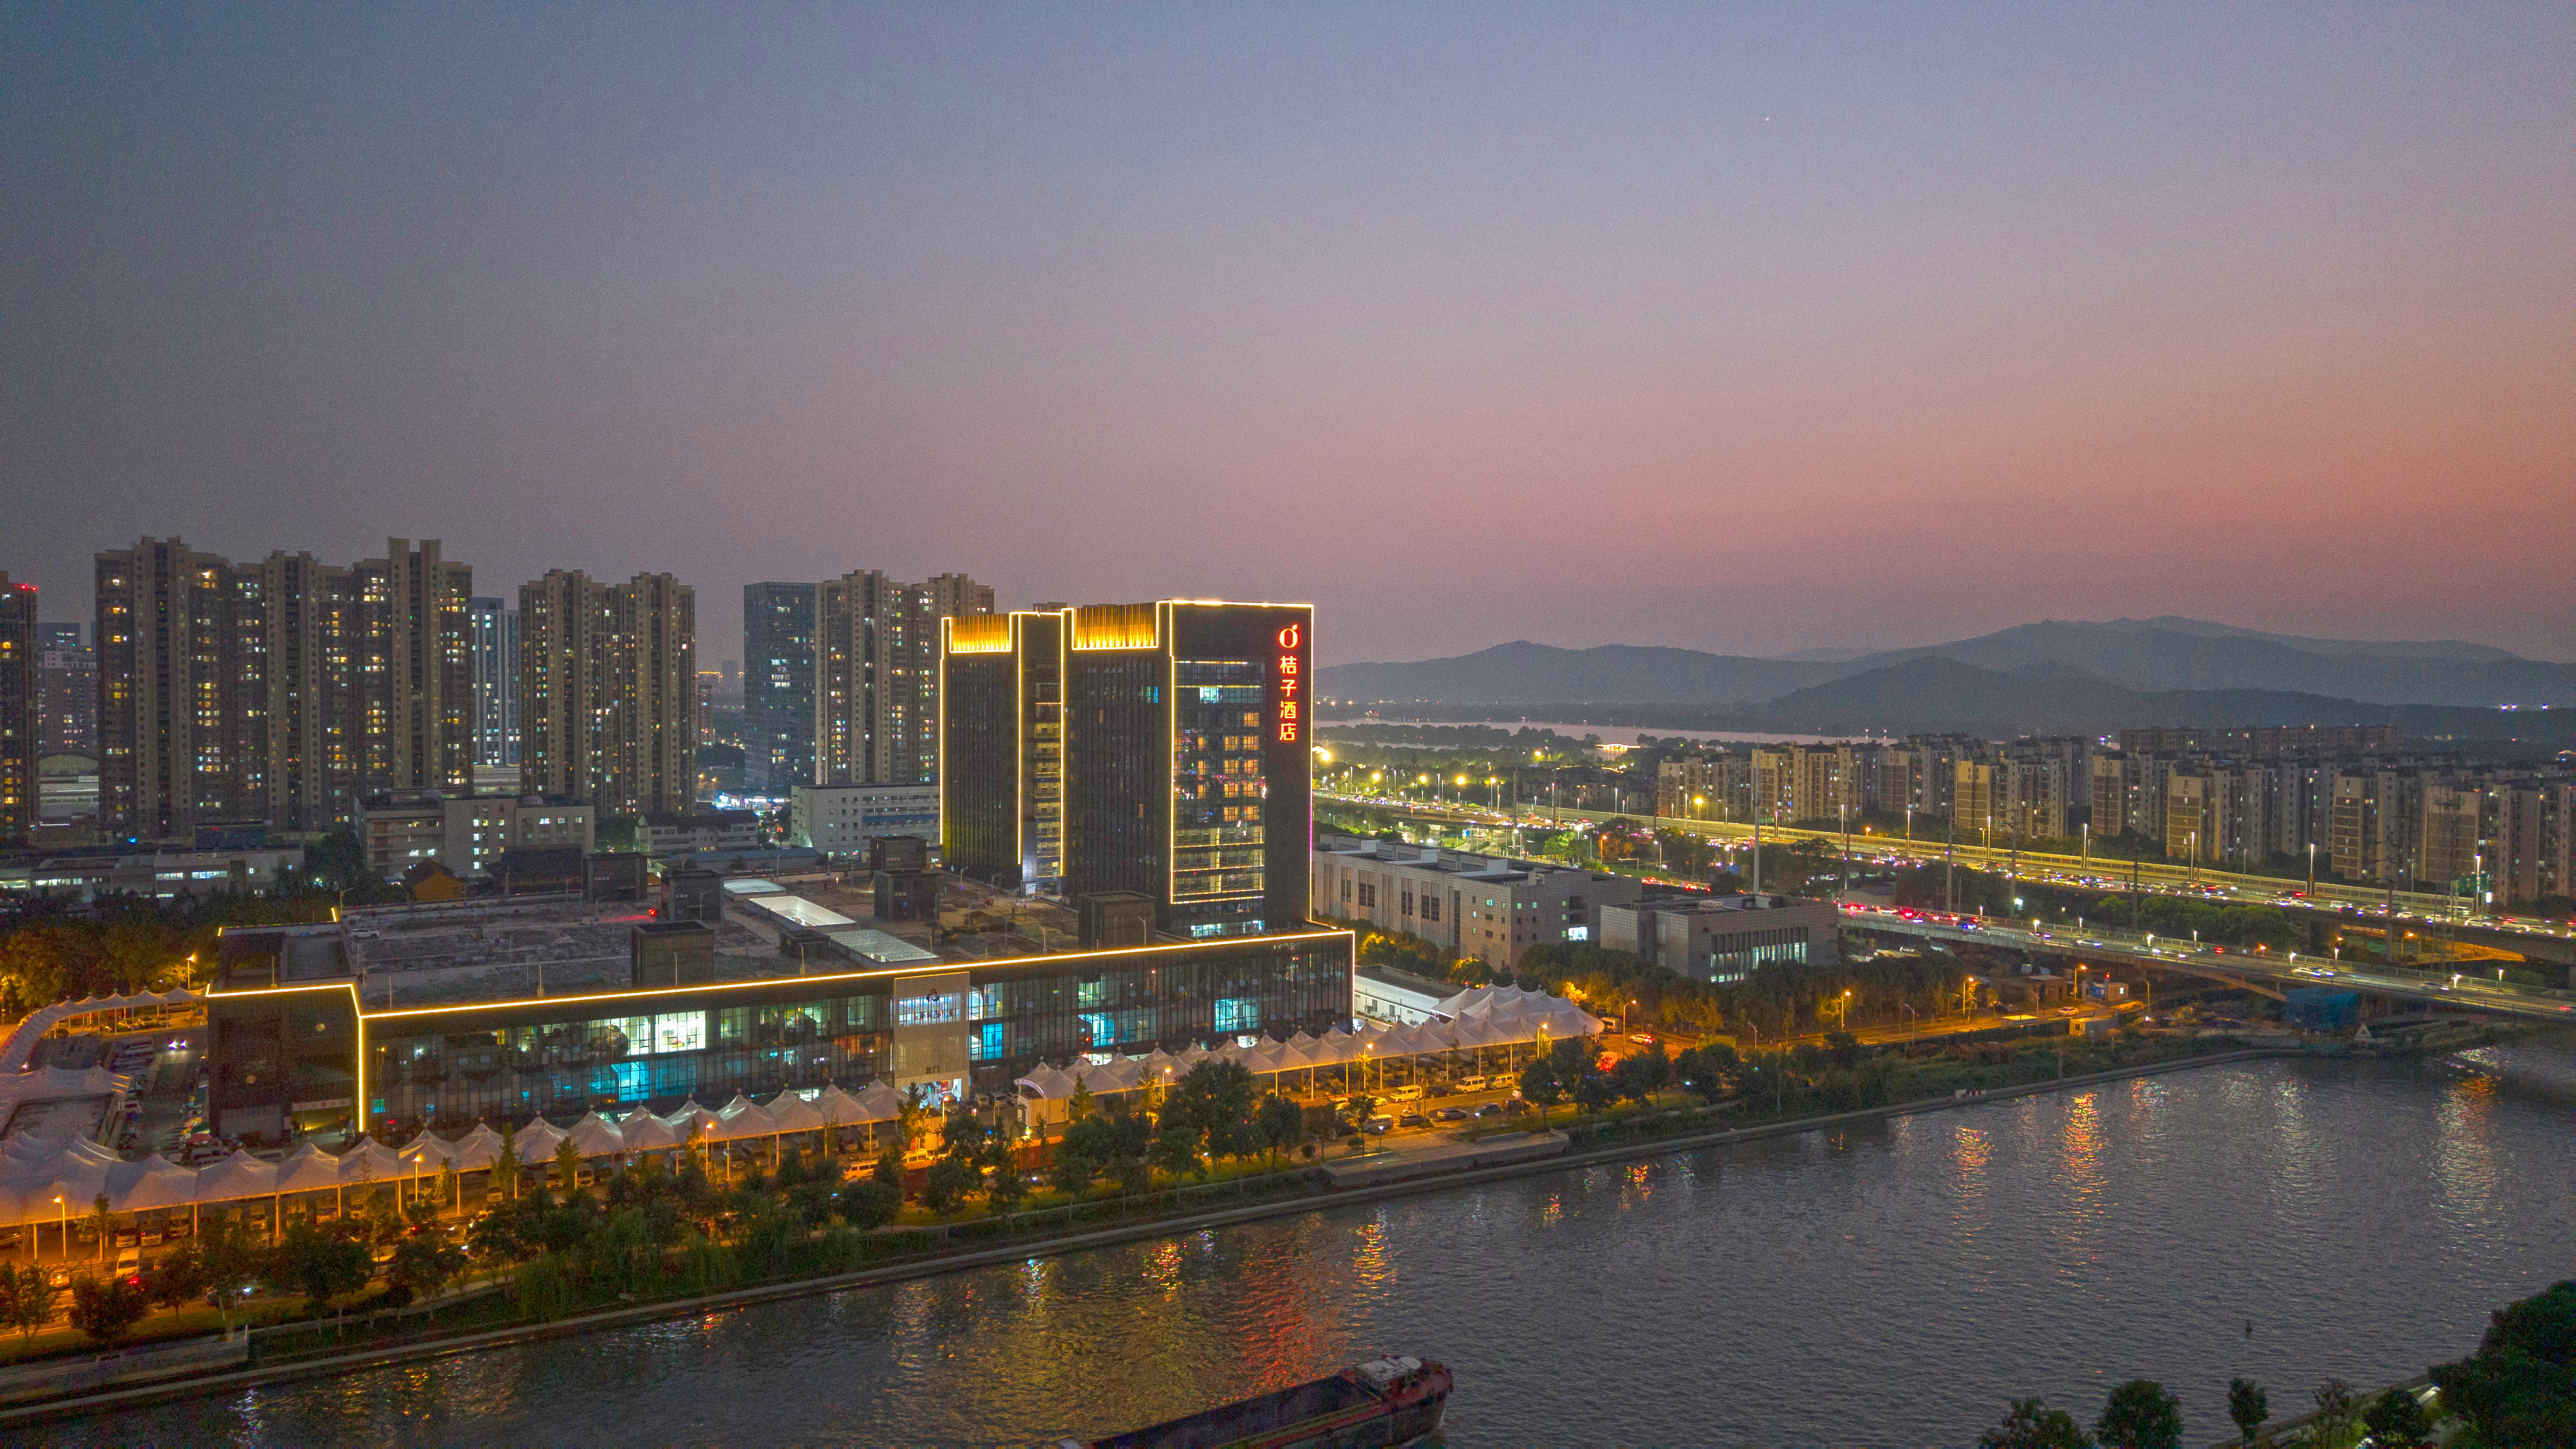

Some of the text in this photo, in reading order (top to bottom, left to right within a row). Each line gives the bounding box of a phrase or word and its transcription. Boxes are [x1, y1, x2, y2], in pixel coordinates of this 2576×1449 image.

[1279, 655, 1297, 741] 桔子酒店
[925, 1065, 940, 1074] 北门
